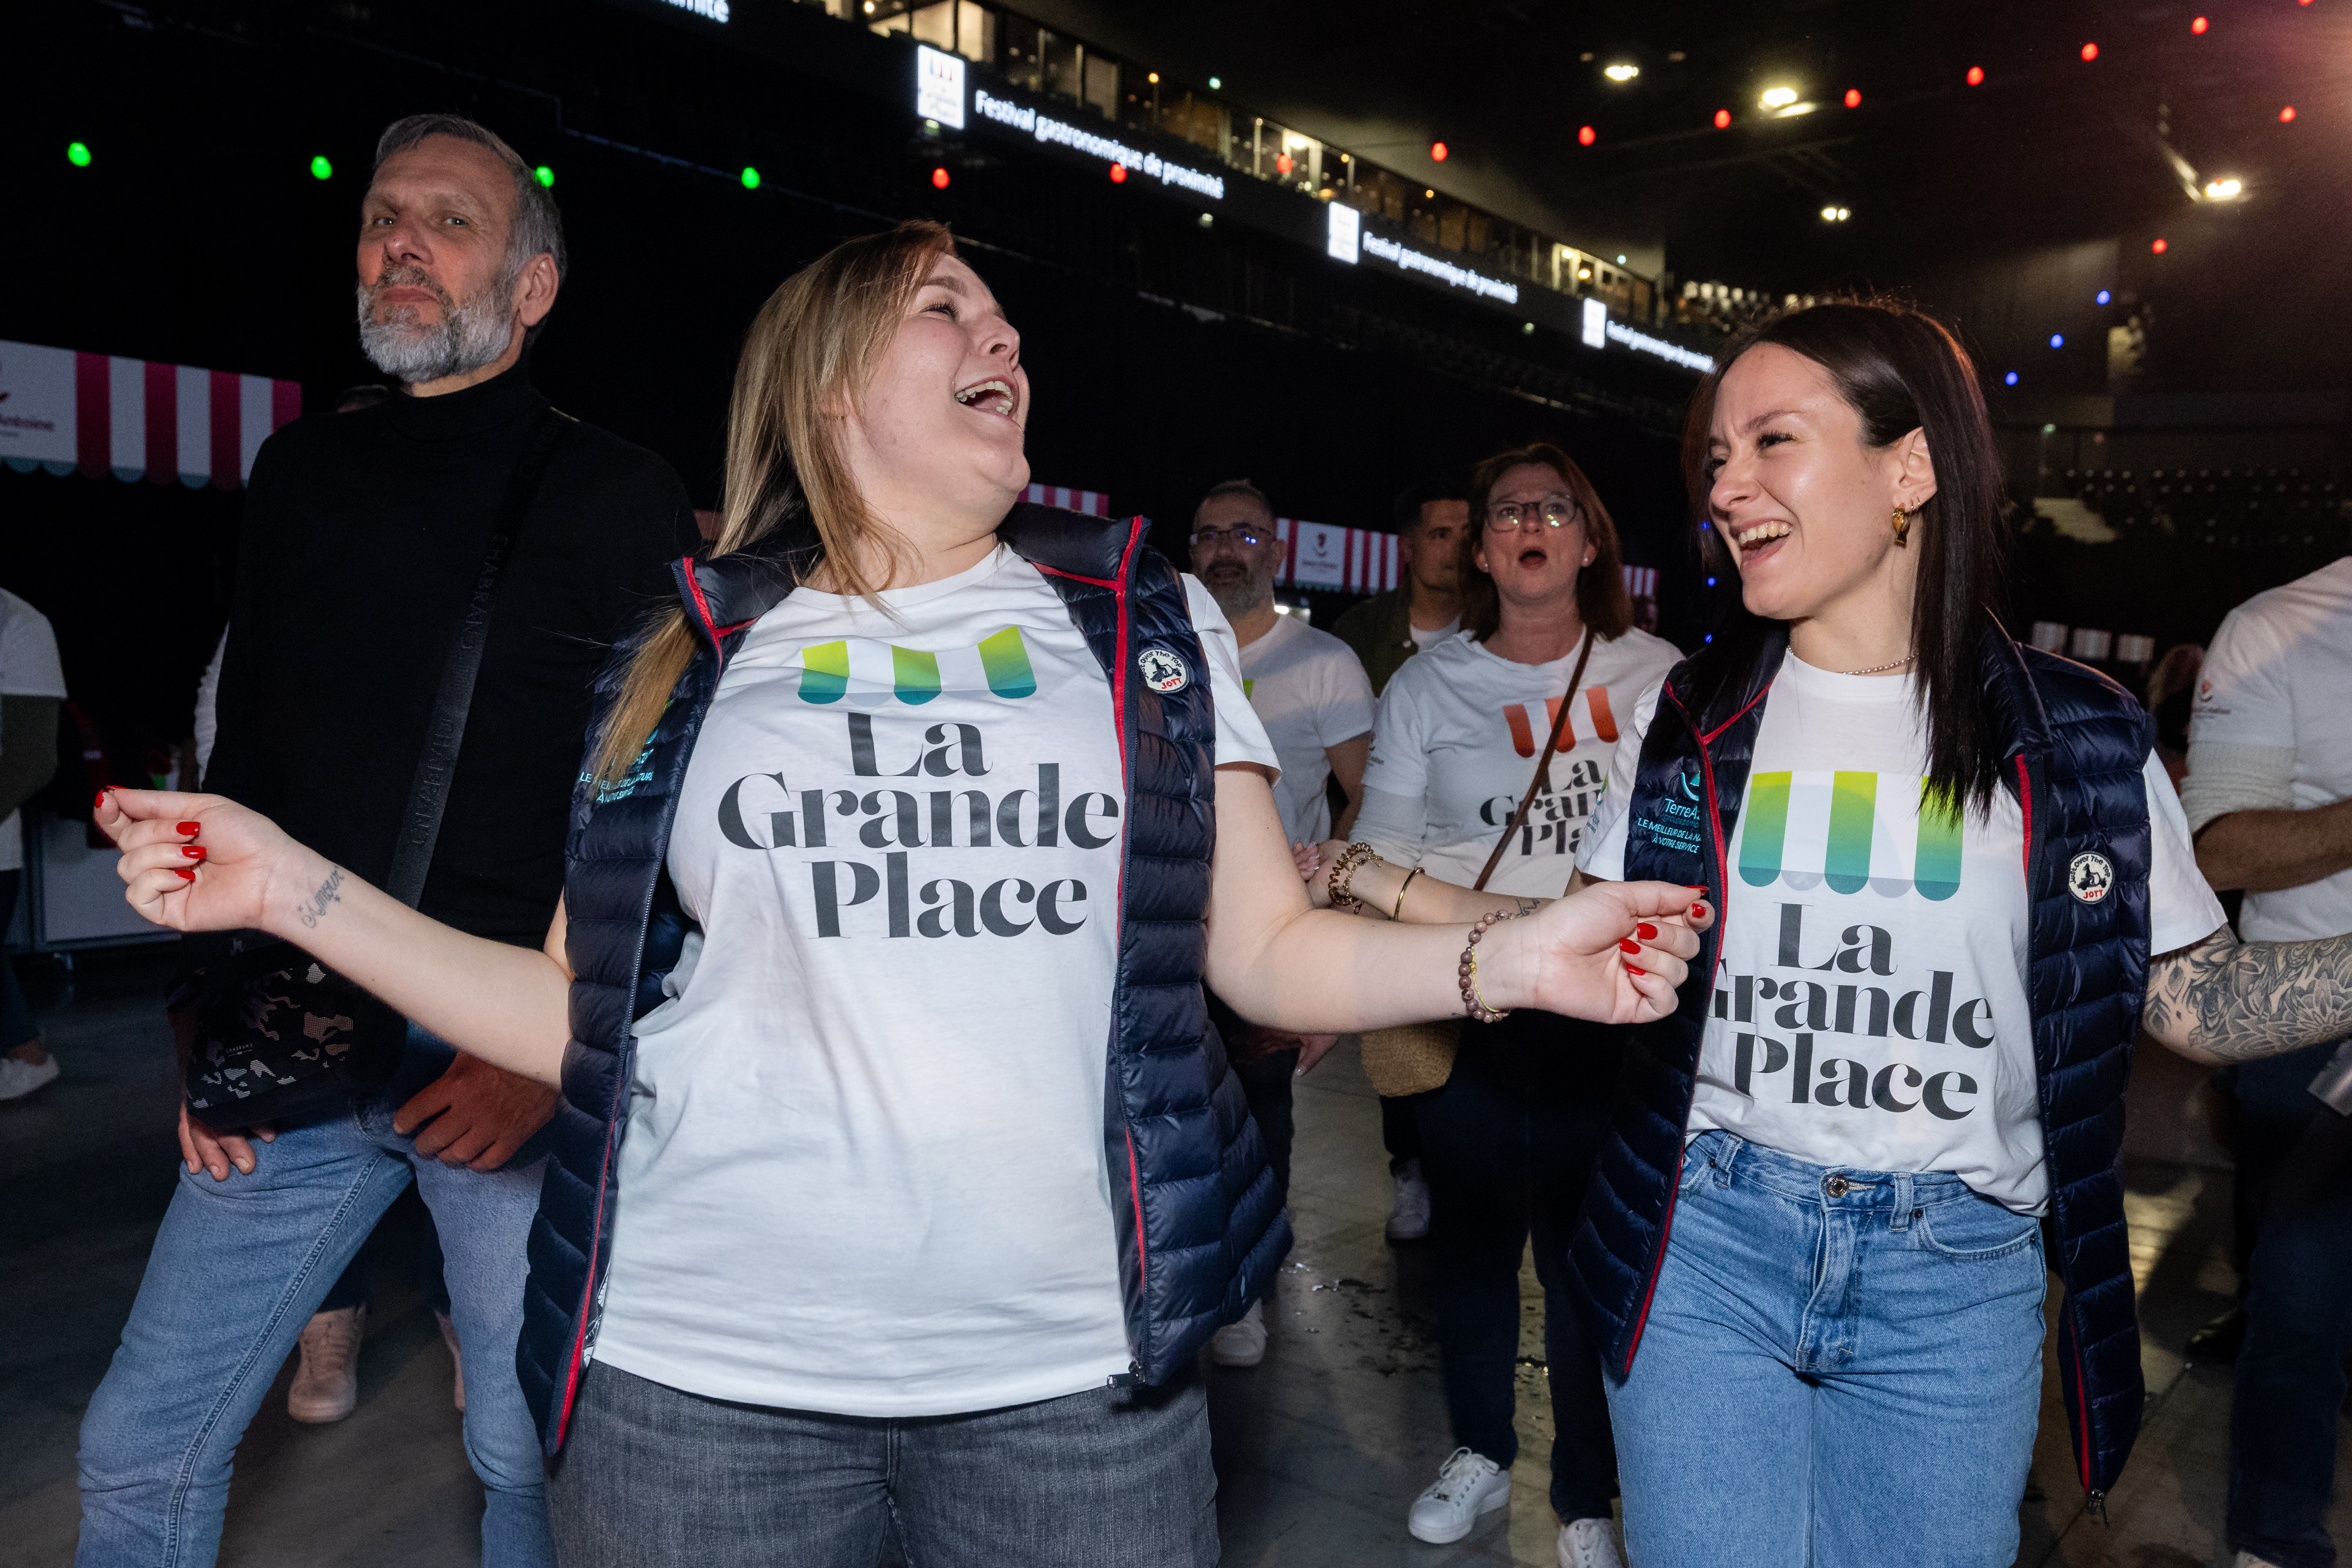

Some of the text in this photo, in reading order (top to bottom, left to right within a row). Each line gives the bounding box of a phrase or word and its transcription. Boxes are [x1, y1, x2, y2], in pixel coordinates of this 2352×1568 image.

[975, 90, 1035, 132] Festival
[1035, 117, 1143, 170] gastronomique
[1144, 152, 1163, 178] de
[1162, 162, 1224, 199] proximité
[1161, 678, 1182, 689] JOTT
[844, 711, 993, 777] La
[718, 763, 1119, 850] Grande
[1480, 789, 1601, 826] Gran
[1638, 817, 1649, 828] LE
[1648, 821, 1678, 836] MEILLEUR
[1677, 829, 1686, 838] DE
[1685, 831, 1693, 840] LA
[1521, 821, 1580, 856] Pla
[1658, 836, 1677, 848] VOTRE
[1675, 841, 1700, 854] SERVICE
[801, 851, 1088, 939] Place
[2083, 889, 2103, 899] JOTT
[1769, 902, 1898, 976] La
[1730, 1032, 1978, 1120] Place
